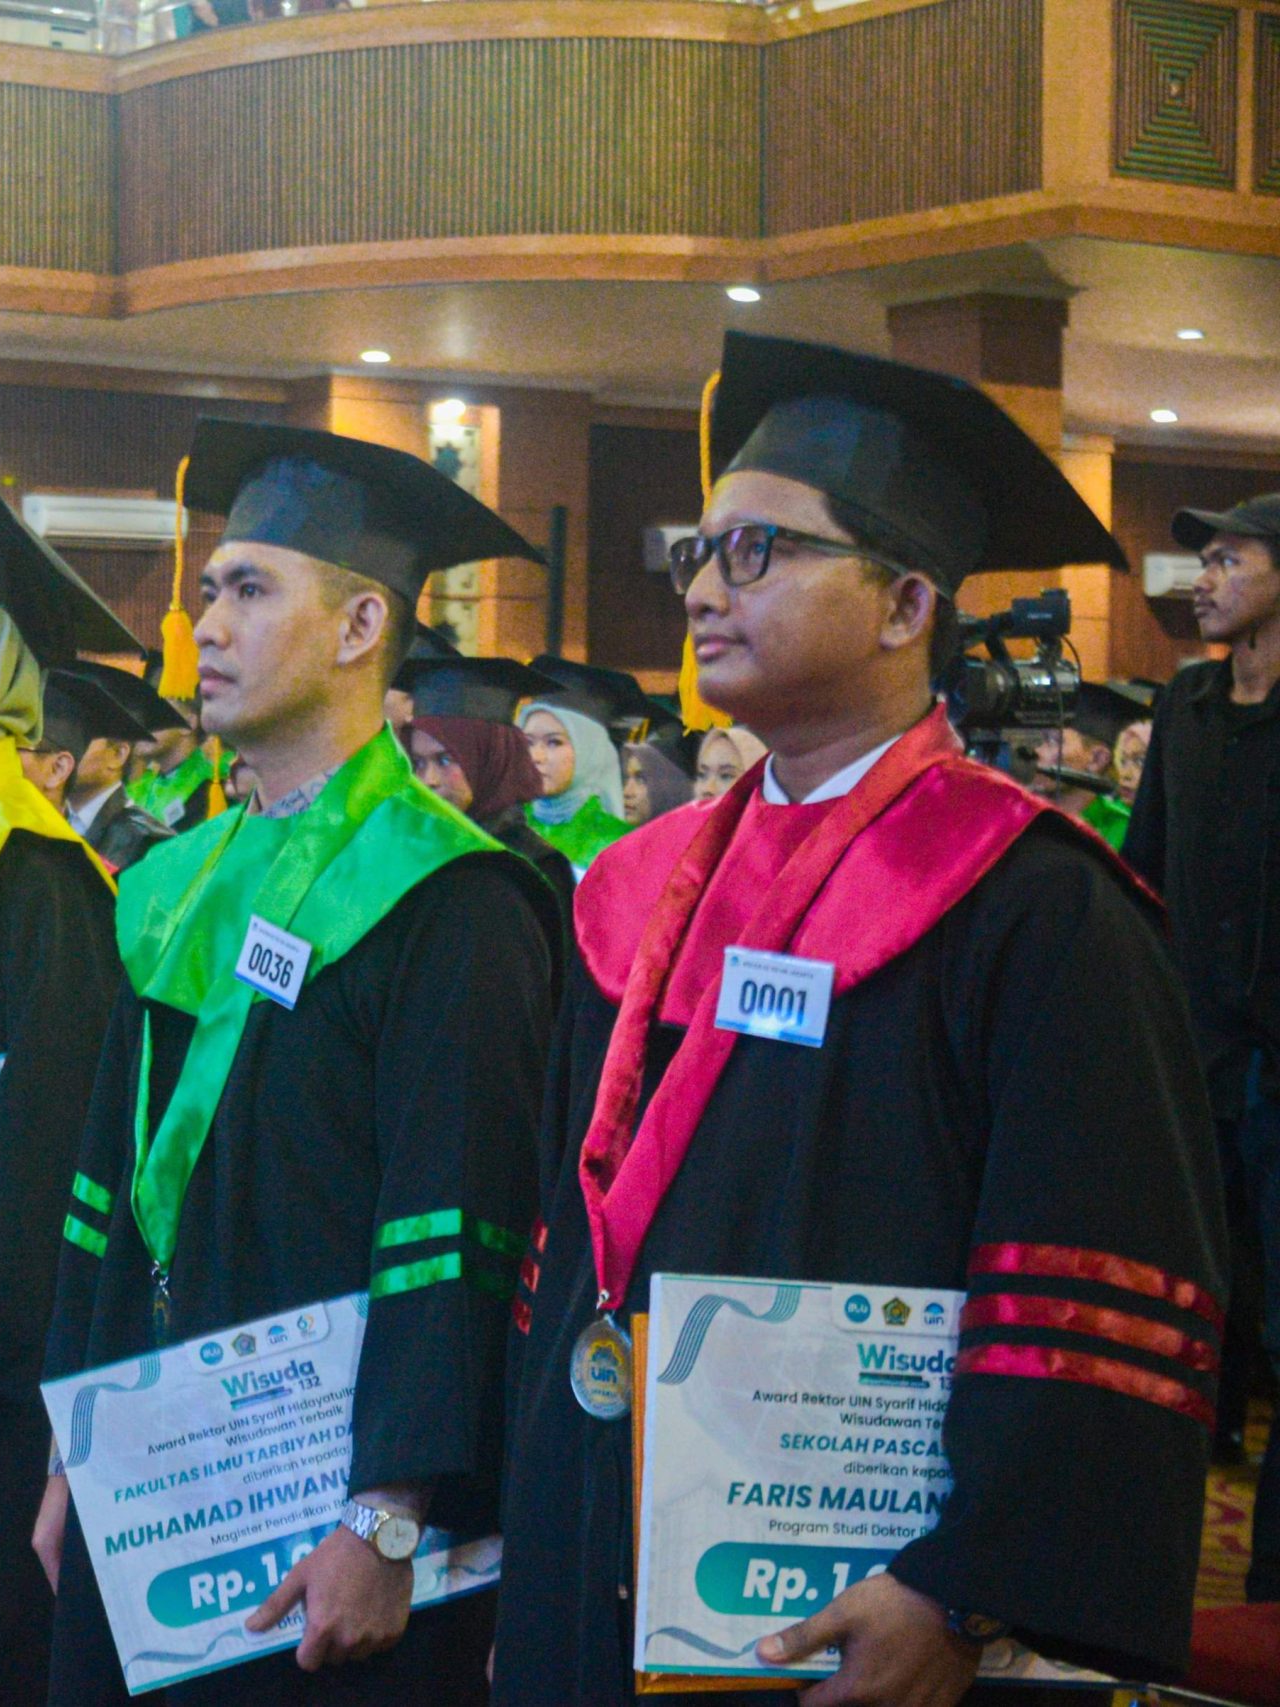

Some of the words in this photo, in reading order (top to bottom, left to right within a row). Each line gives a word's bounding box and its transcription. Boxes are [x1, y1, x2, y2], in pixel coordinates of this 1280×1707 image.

[248, 943, 294, 988] 0036
[739, 980, 807, 1026] 0001
[221, 1360, 315, 1397] Wisuda
[298, 1375, 321, 1391] 132
[753, 1390, 798, 1404] Award
[801, 1392, 845, 1407] Rektor
[849, 1396, 871, 1408] UIN
[876, 1396, 915, 1412] Syarif
[840, 1413, 921, 1428] Wisudawan
[147, 1436, 187, 1455] Award
[188, 1425, 226, 1443] Rektor
[228, 1418, 250, 1431] UIN
[252, 1405, 287, 1425] Syarif
[226, 1419, 297, 1447] Wisudawan
[299, 1404, 344, 1424] Terbaik
[780, 1433, 869, 1454] SEKOLAH
[872, 1438, 947, 1457] PASCA
[113, 1466, 200, 1503] FAKULTAS
[203, 1454, 243, 1477] ILMU
[245, 1428, 332, 1464] TARBIYAH
[242, 1462, 299, 1485] diberikan
[843, 1461, 908, 1477] diberikan
[727, 1481, 813, 1508] FARIS
[105, 1499, 243, 1556] MUHAMAD
[211, 1522, 263, 1546] Magister
[265, 1503, 332, 1531] Pendidikan
[769, 1519, 829, 1537] Program
[833, 1522, 867, 1536] Studi
[871, 1524, 916, 1538] Doktor
[189, 1570, 255, 1613] Rp.
[742, 1558, 819, 1613] Rp.
